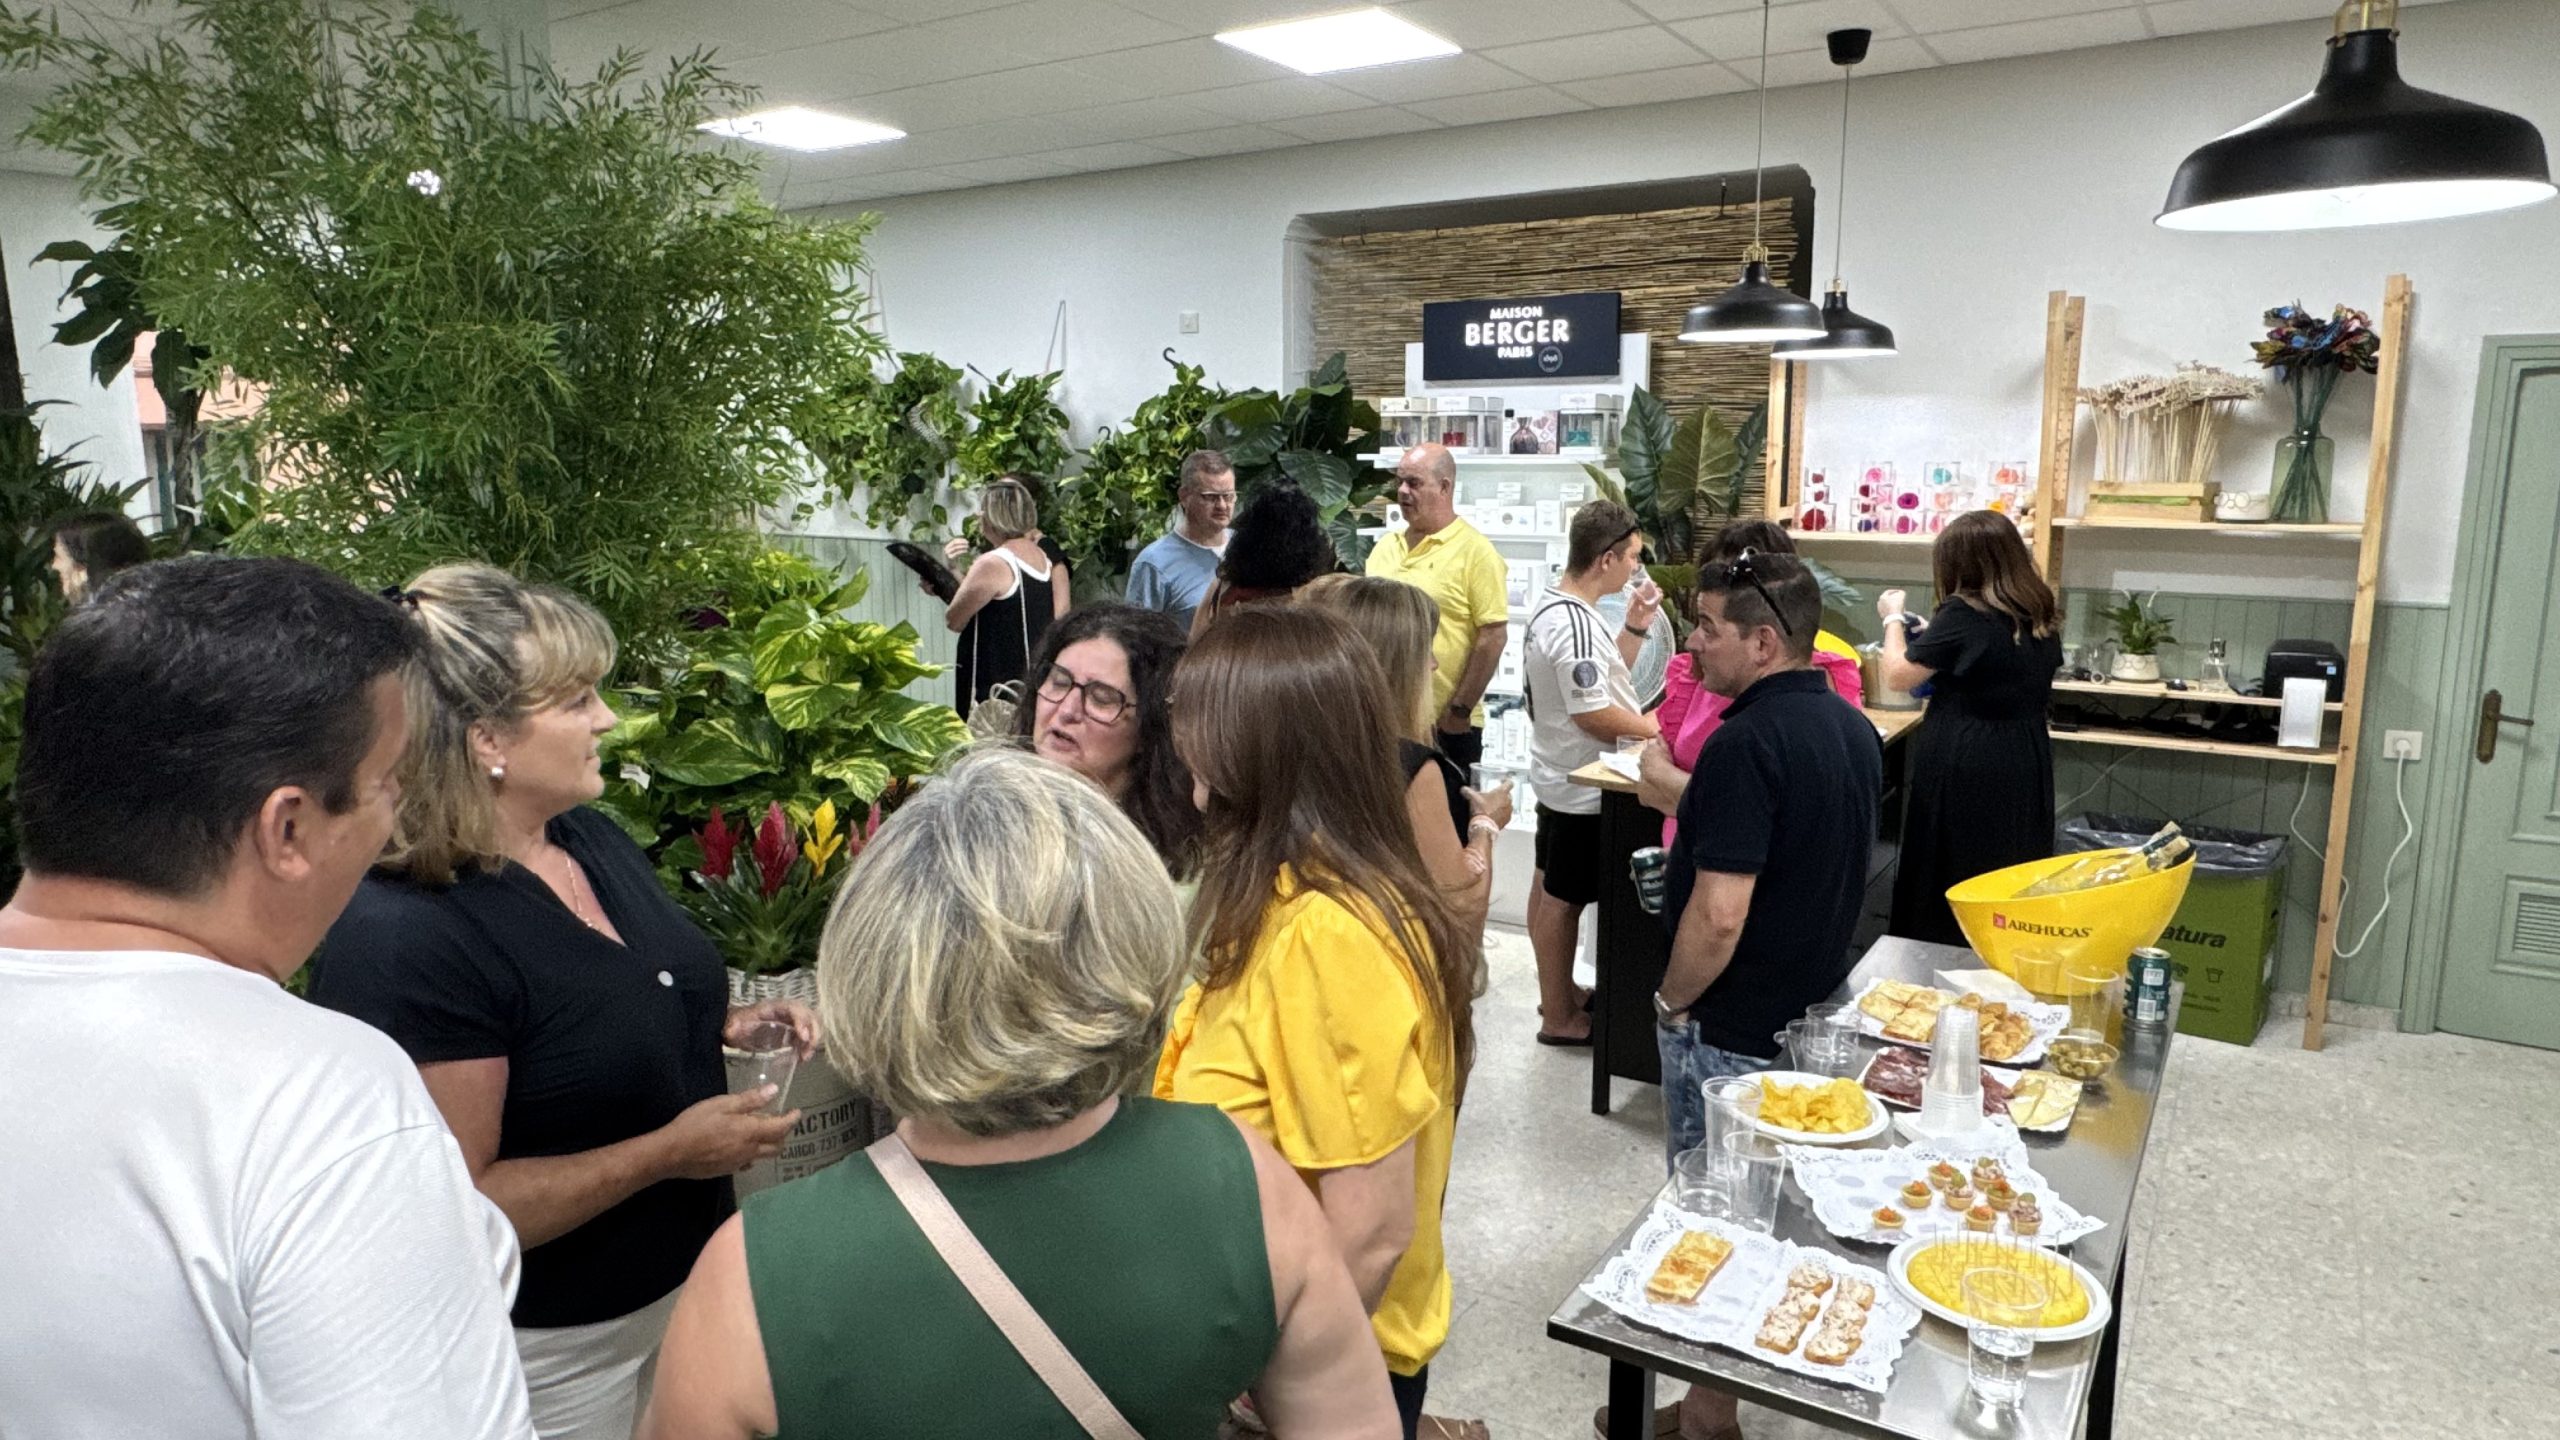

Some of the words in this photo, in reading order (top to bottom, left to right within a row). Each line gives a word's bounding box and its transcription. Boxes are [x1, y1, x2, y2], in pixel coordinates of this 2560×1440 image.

[1489, 305, 1543, 320] MAISON
[1464, 318, 1570, 347] BERGER
[1497, 345, 1534, 359] PARIS
[2008, 919, 2091, 938] AREHUCAS
[2161, 924, 2226, 949] atura
[793, 1098, 856, 1137] ACTORY
